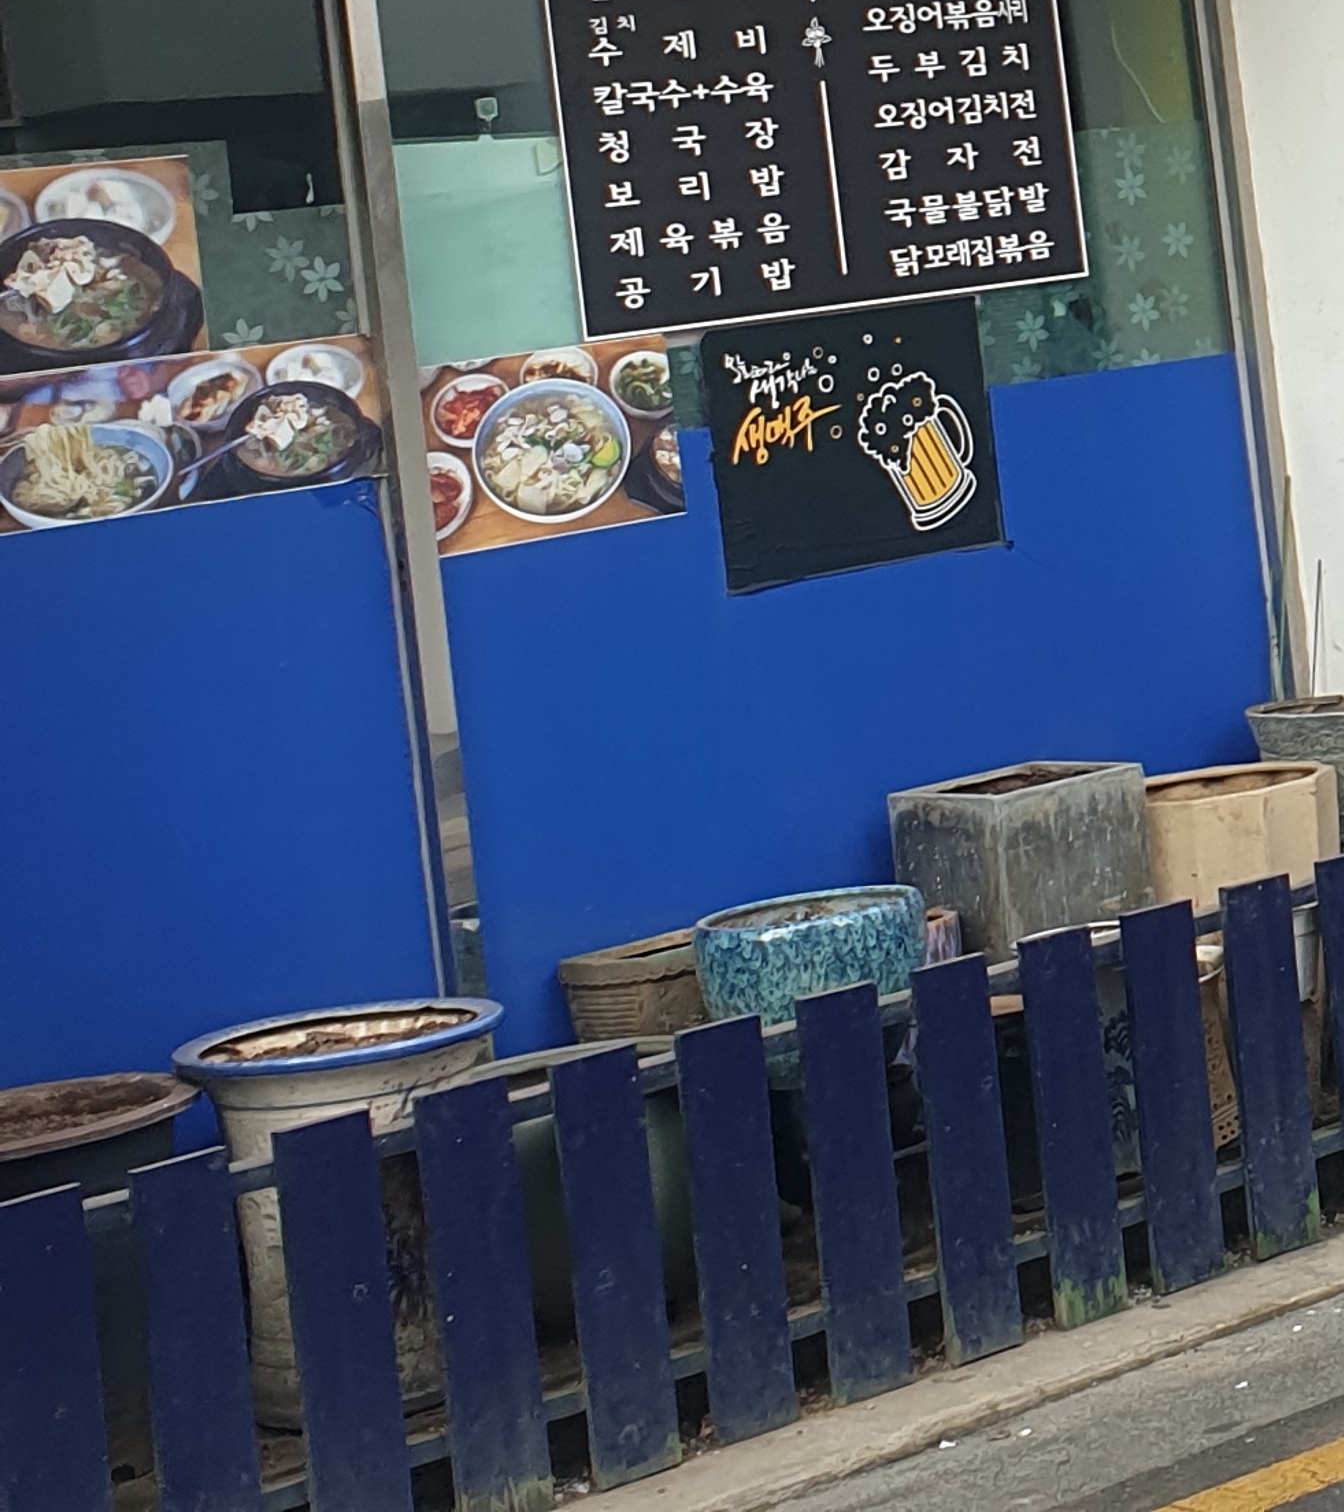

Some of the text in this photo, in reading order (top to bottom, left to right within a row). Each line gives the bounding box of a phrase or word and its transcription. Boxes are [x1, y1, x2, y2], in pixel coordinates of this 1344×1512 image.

[594, 72, 774, 117] 칼국수+수육
[874, 90, 1038, 130] 오징어김치전
[885, 181, 1050, 225] 국물불닭발
[890, 230, 1056, 277] 닭모래집볶음
[733, 395, 843, 466] 생맥주
